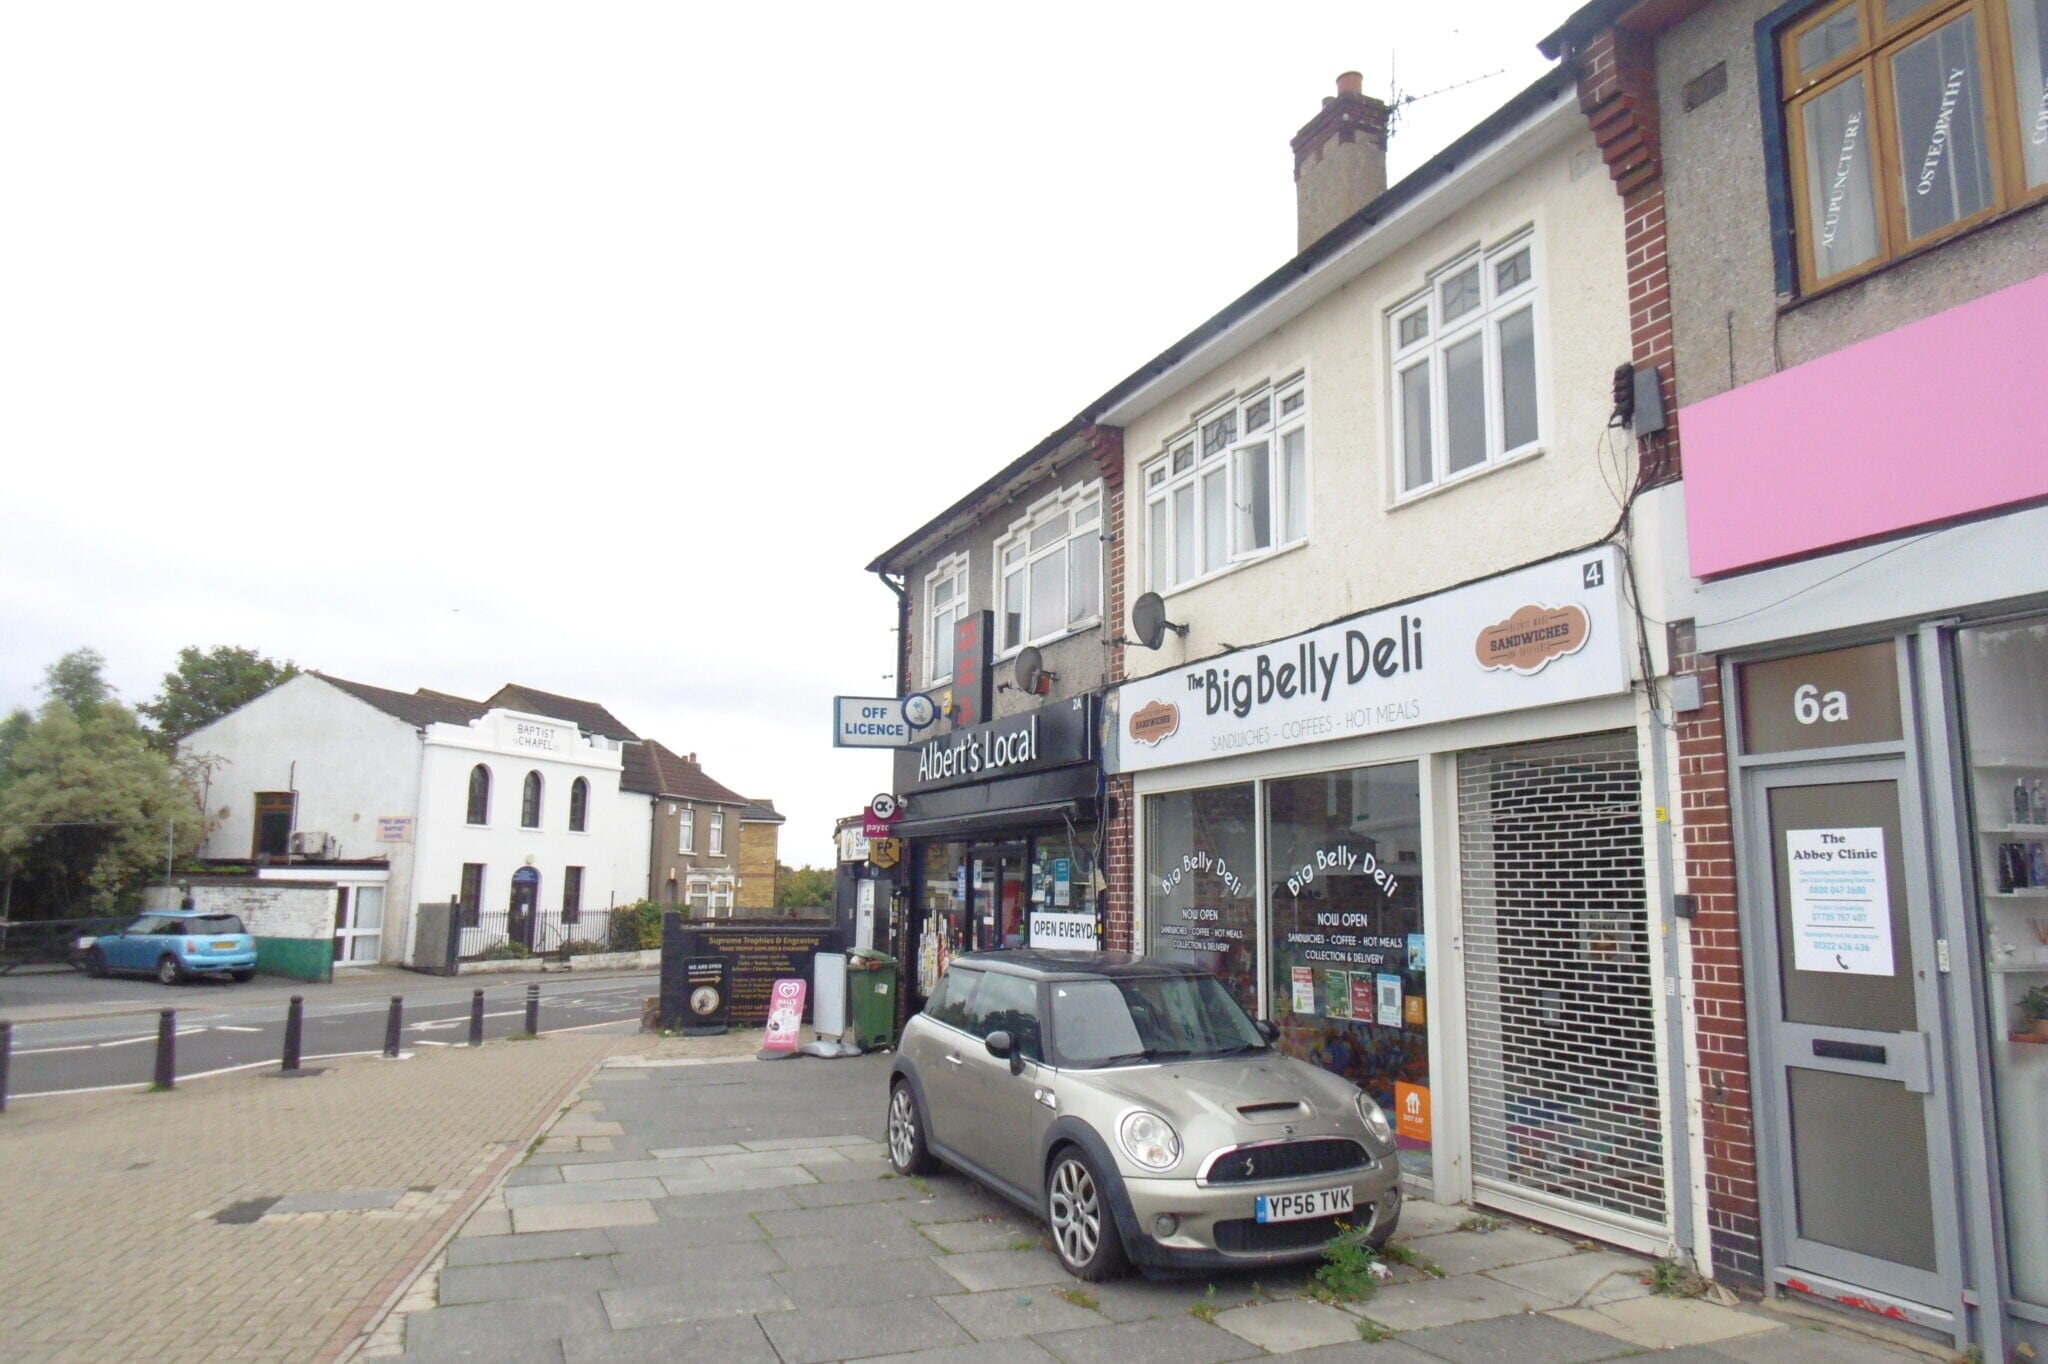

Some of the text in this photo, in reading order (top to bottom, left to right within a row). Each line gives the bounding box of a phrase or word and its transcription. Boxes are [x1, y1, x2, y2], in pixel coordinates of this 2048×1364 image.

[1917, 68, 1965, 195] OSTEOPATHY
[1822, 111, 1862, 248] ACUPUNCTURE
[1585, 562, 1601, 585] 4
[1490, 622, 1569, 652] SANDWICHES
[1187, 615, 1423, 718] The Big Belly Deli
[1072, 698, 1081, 711] 2A
[1794, 684, 1849, 725] 6a
[862, 707, 888, 719] OFF
[517, 723, 555, 739] BAPTIST
[845, 723, 904, 736] LICENCE
[1211, 699, 1421, 752] SANDWICHES COFFEES HOT MEALS
[518, 736, 553, 750] CHAPEL
[918, 714, 1037, 783] Albert's Local
[1821, 834, 1846, 844] The
[1793, 848, 1879, 861] Abbey Clinic
[1162, 851, 1241, 895] Big Belly Deli
[1287, 845, 1398, 897] Big Belly Deli
[1182, 908, 1218, 920] NOW OPEN
[1317, 913, 1368, 927] NOW OPEN
[1034, 920, 1057, 937] OPEN
[1191, 928, 1210, 937] COFFEE
[1214, 929, 1225, 938] HOT
[1226, 930, 1243, 939] MEALS
[709, 936, 742, 946] Supreme
[743, 936, 774, 945] Trophies
[783, 936, 819, 946] Engraving
[1173, 940, 1201, 950] COLLECTION
[1207, 943, 1230, 953] DELIVERY
[1288, 933, 1403, 948] SANDWICHES COFFEE HOT MEALS
[1305, 950, 1384, 965] COLLECTION & DELIVERY
[1269, 1189, 1350, 1217] YP56 TVK
